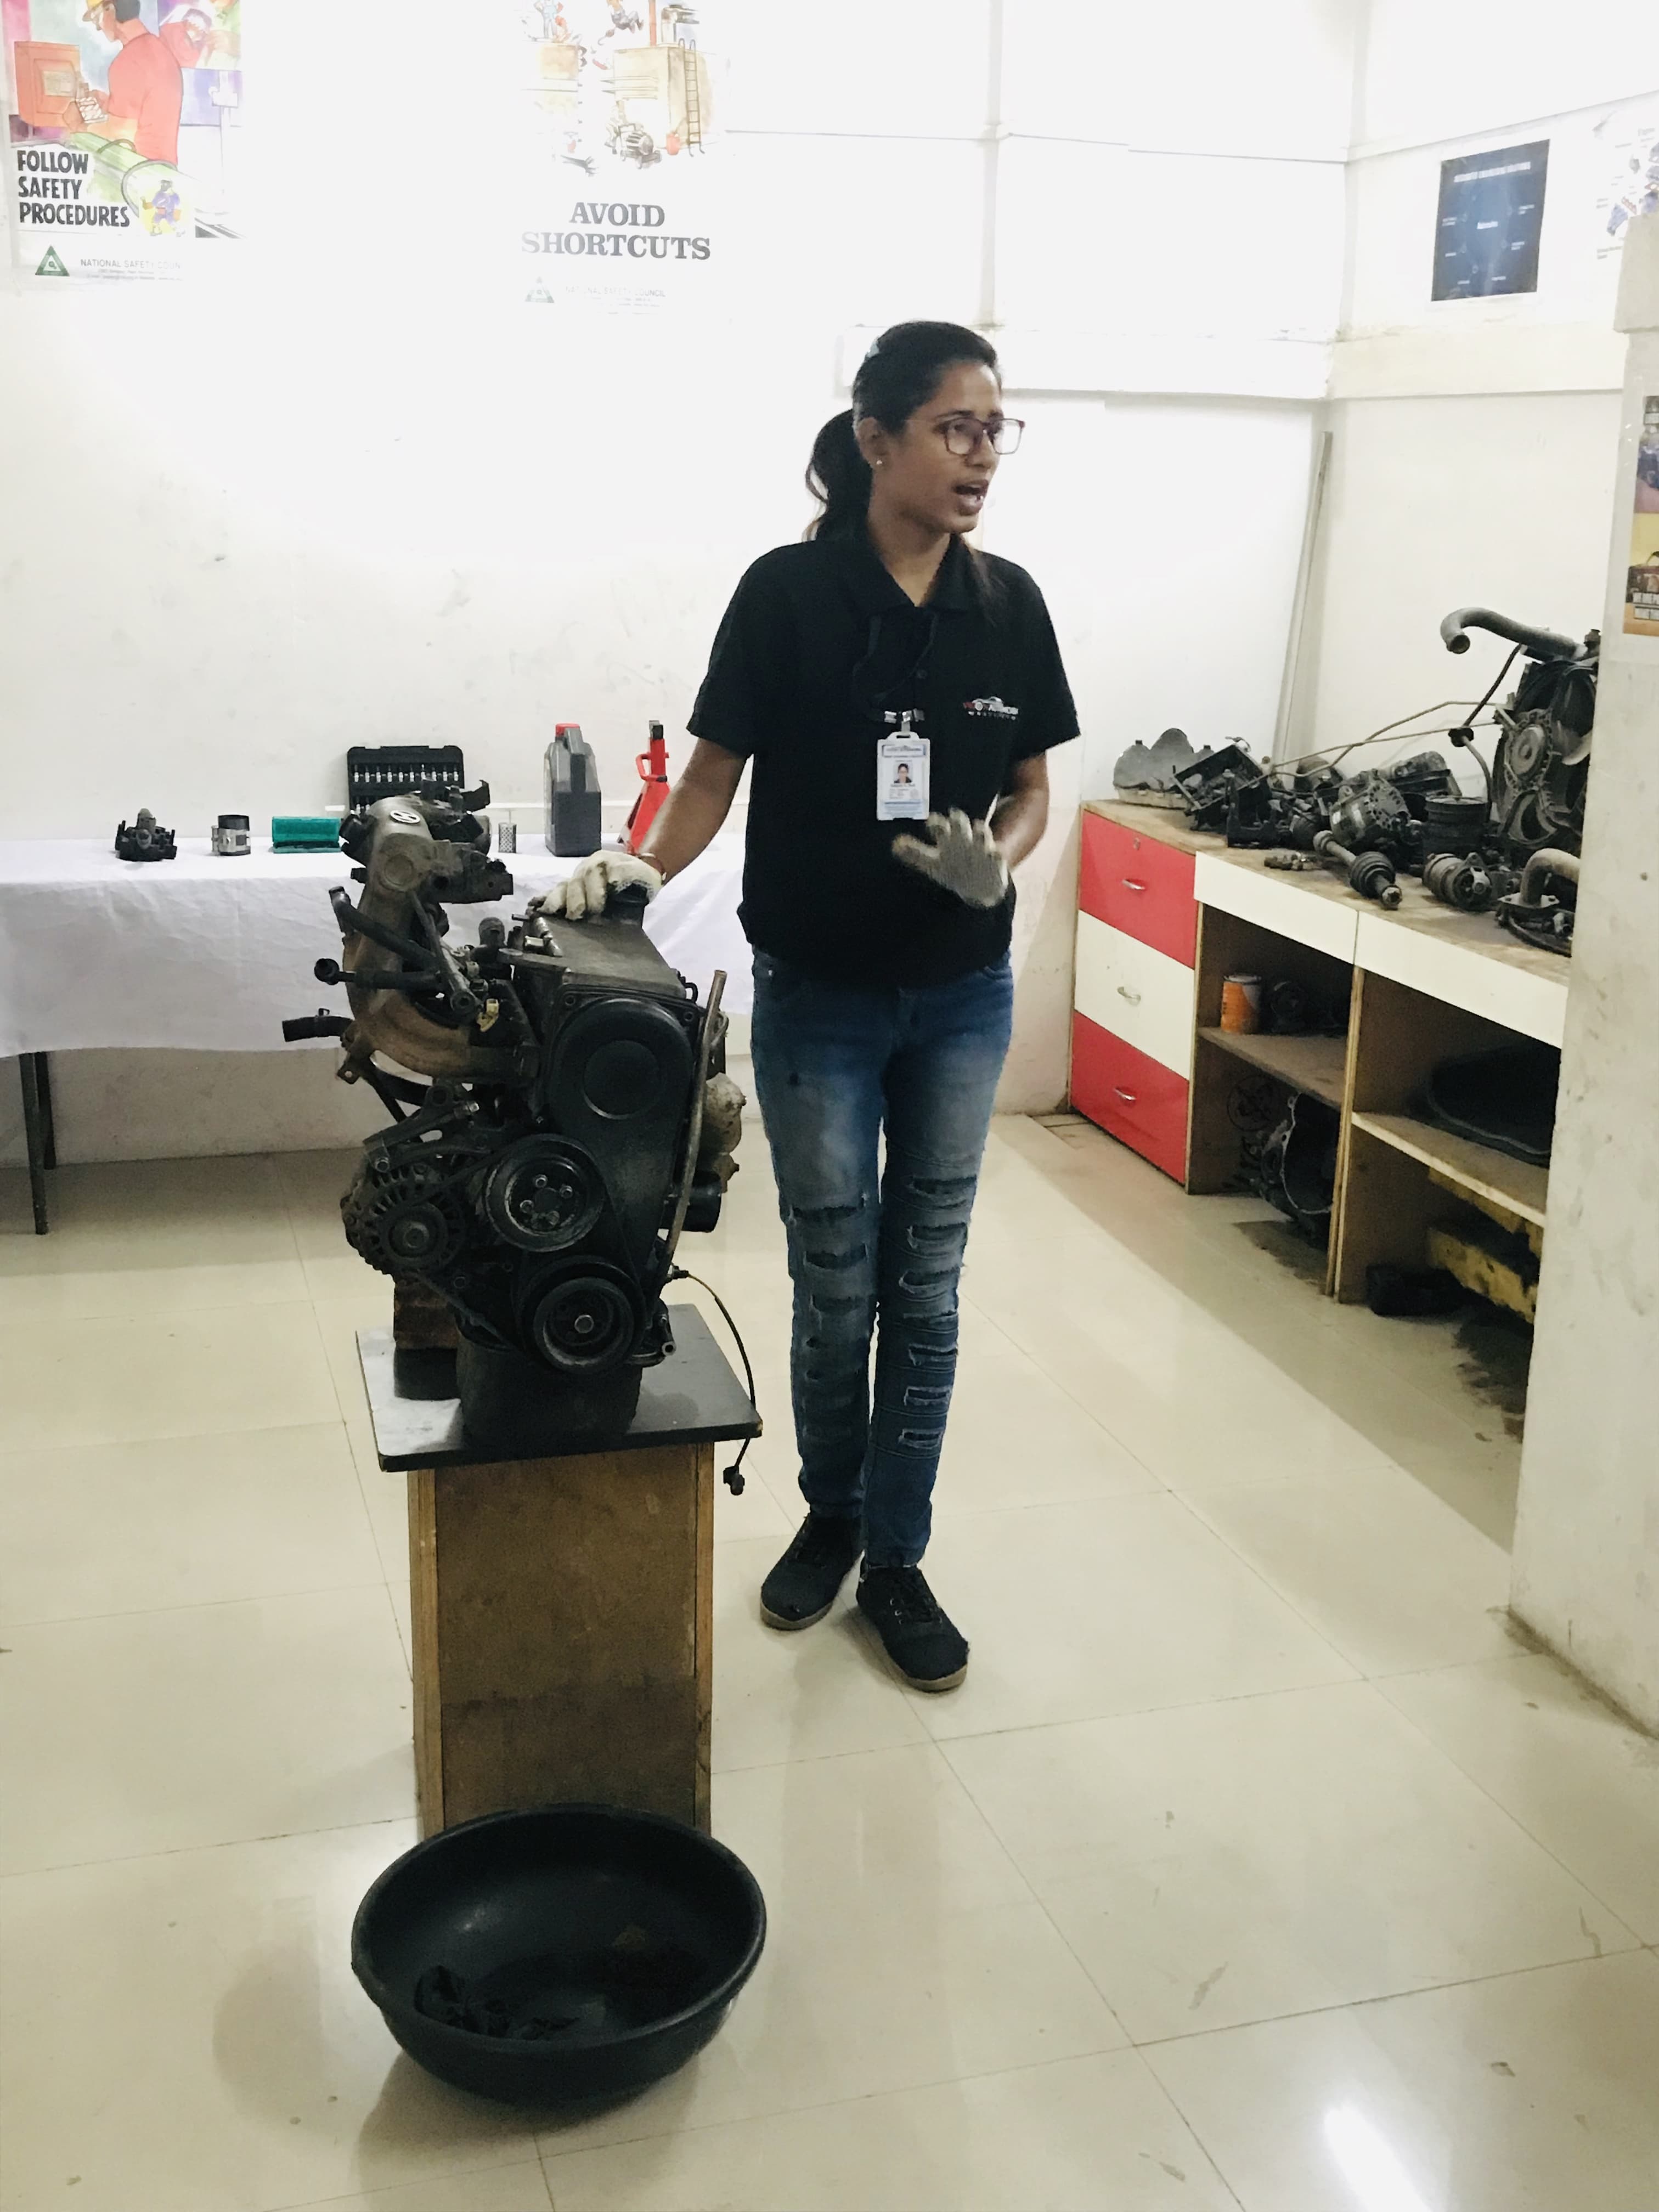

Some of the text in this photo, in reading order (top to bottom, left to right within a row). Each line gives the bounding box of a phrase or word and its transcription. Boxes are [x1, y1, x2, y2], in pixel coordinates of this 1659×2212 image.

[17, 150, 89, 174] FOLLOW
[18, 176, 82, 200] SAFETY
[19, 202, 130, 227] PROCEDURES
[569, 202, 665, 227] AVOID
[522, 231, 710, 260] SHORTCUTS
[81, 259, 121, 268] NATIONAL
